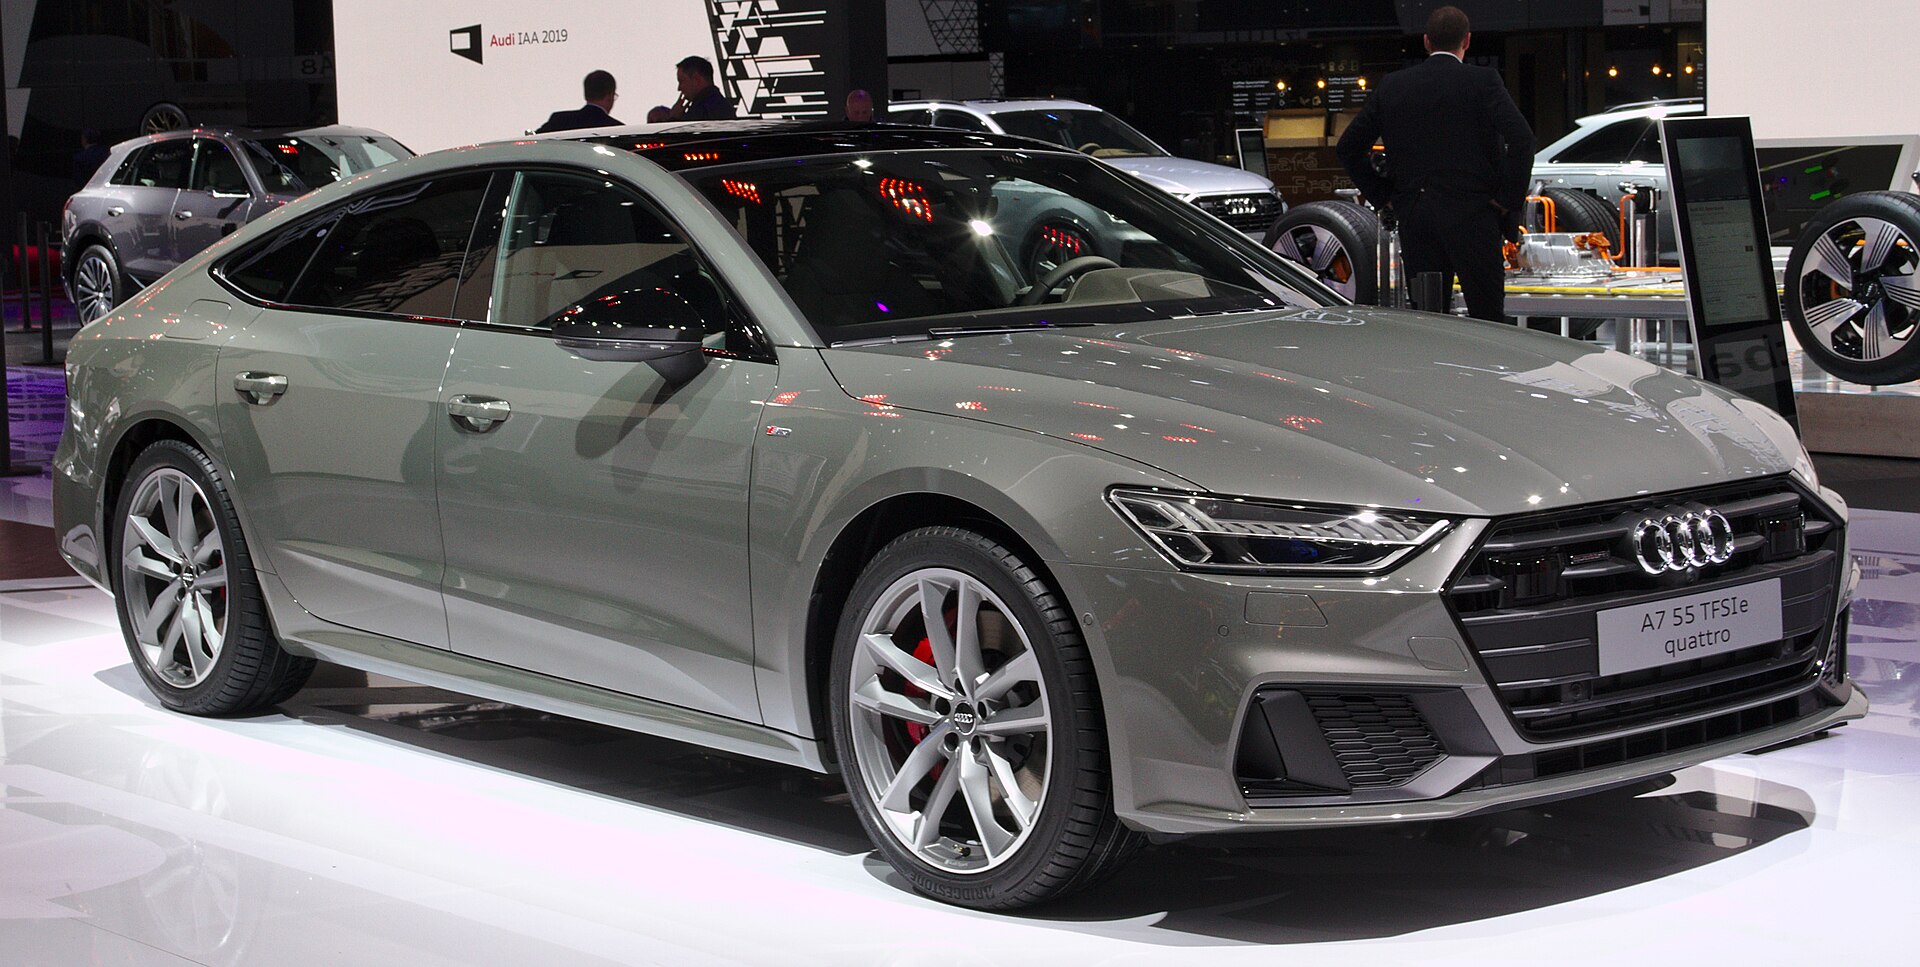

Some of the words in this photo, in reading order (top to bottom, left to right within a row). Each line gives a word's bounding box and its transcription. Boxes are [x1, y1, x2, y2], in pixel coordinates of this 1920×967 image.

[490, 33, 515, 47] Audi
[518, 32, 539, 45] IAA
[542, 29, 568, 43] 2019
[1641, 611, 1666, 632] A7
[1673, 605, 1695, 626] 55
[1699, 597, 1749, 620] TFSIe
[1665, 628, 1731, 657] quattro
